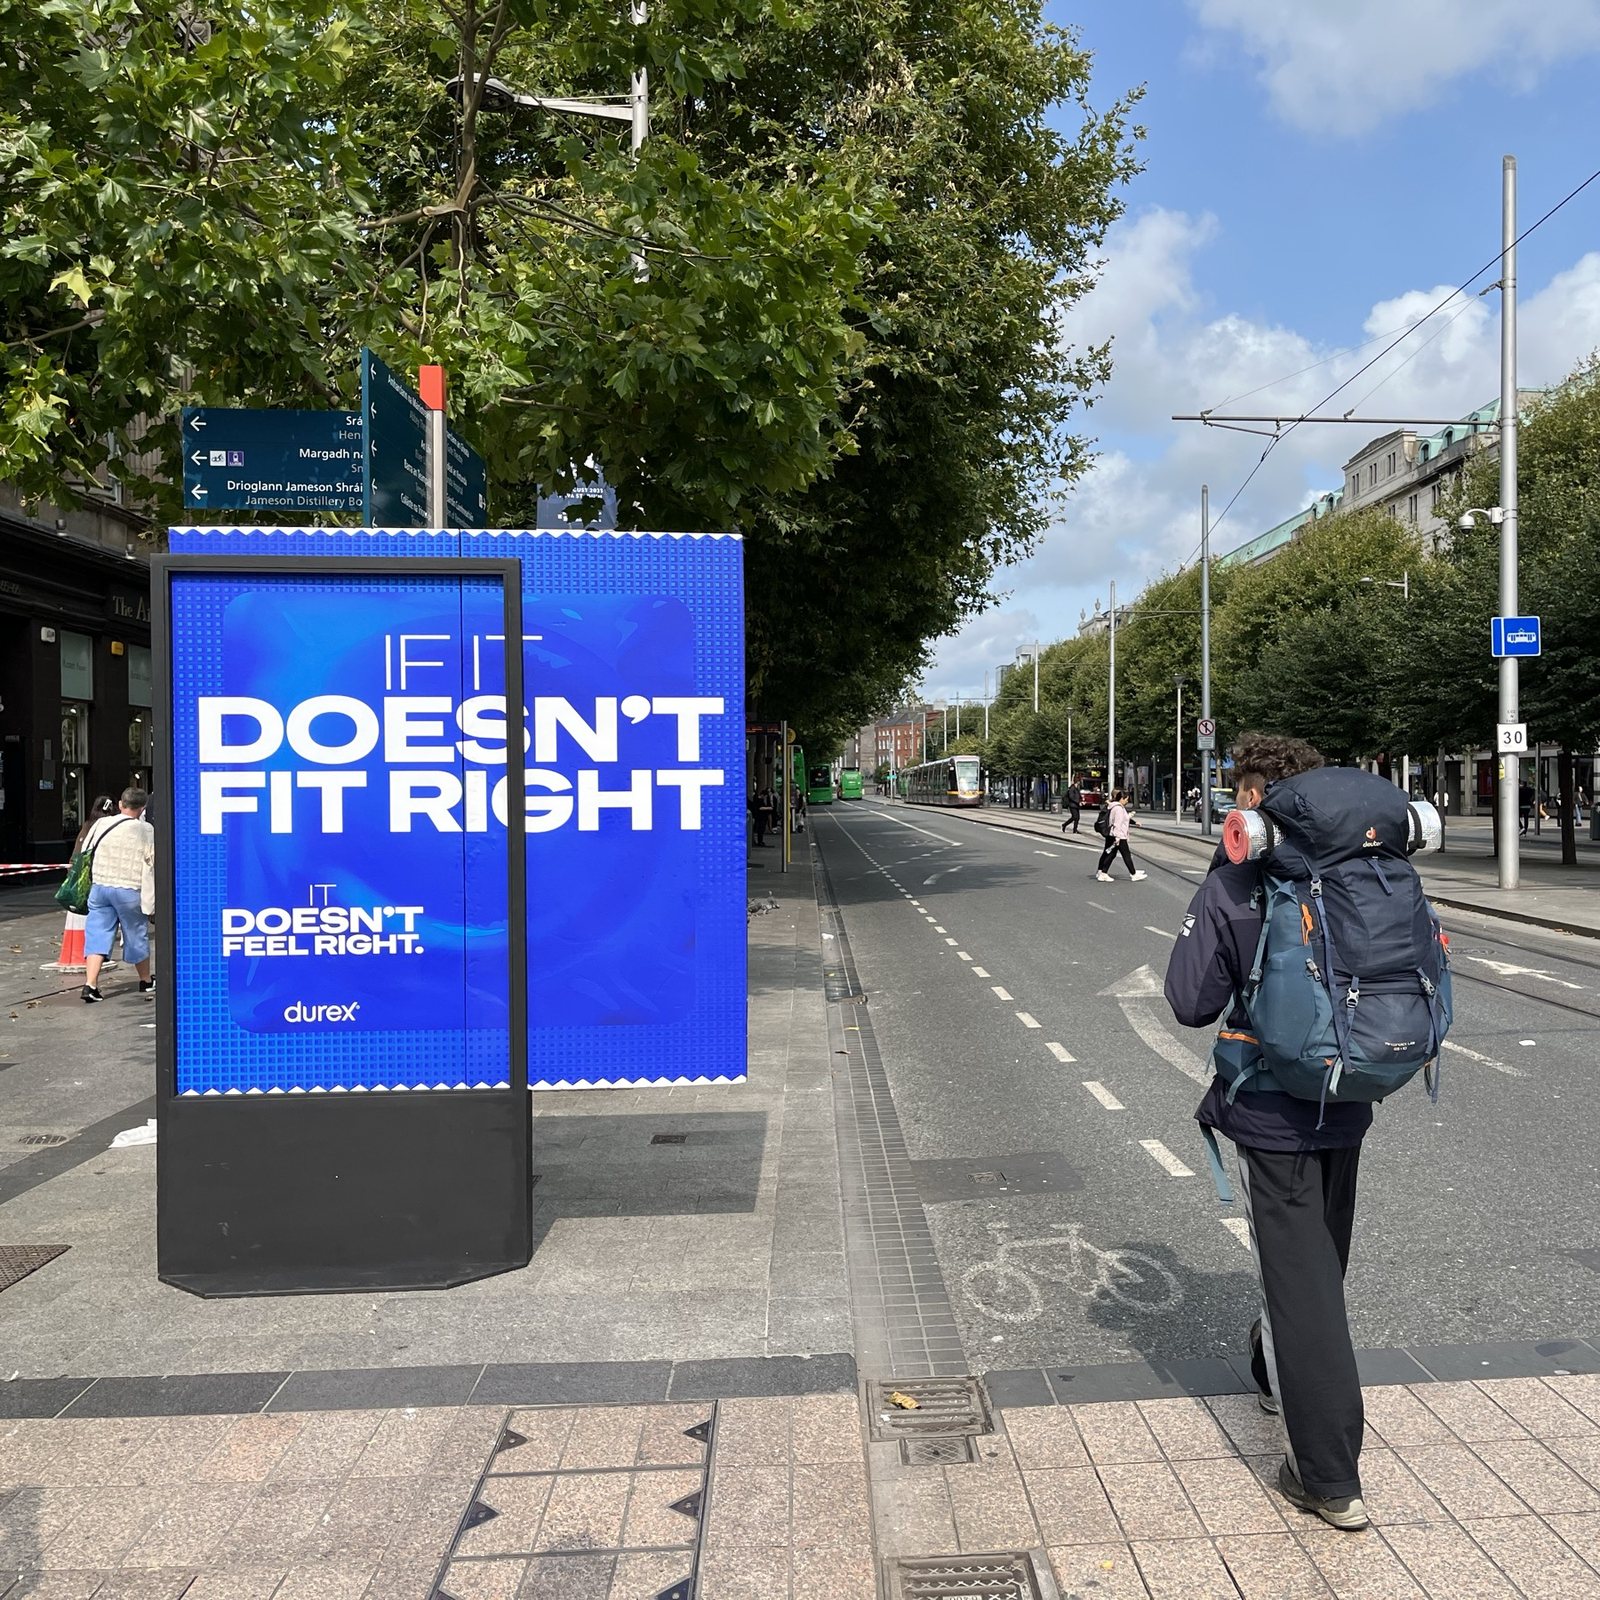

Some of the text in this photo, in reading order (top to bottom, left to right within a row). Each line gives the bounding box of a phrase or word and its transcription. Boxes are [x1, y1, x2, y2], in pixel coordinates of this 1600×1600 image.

[346, 415, 363, 426] Srá
[339, 430, 363, 440] Hen
[299, 449, 350, 461] Margadh
[227, 480, 363, 493] Drioglann Jameson Shrái
[245, 496, 363, 508] Jameson Distillery Bo
[386, 634, 451, 690] IF
[198, 694, 725, 765] DOESN'T
[1503, 730, 1523, 744] 30
[200, 768, 725, 835] FIT RIGHT
[309, 884, 337, 906] IT
[222, 906, 424, 935] DOESN'T
[222, 934, 424, 957] FEEL RIGHT.
[284, 1001, 359, 1023] durex
